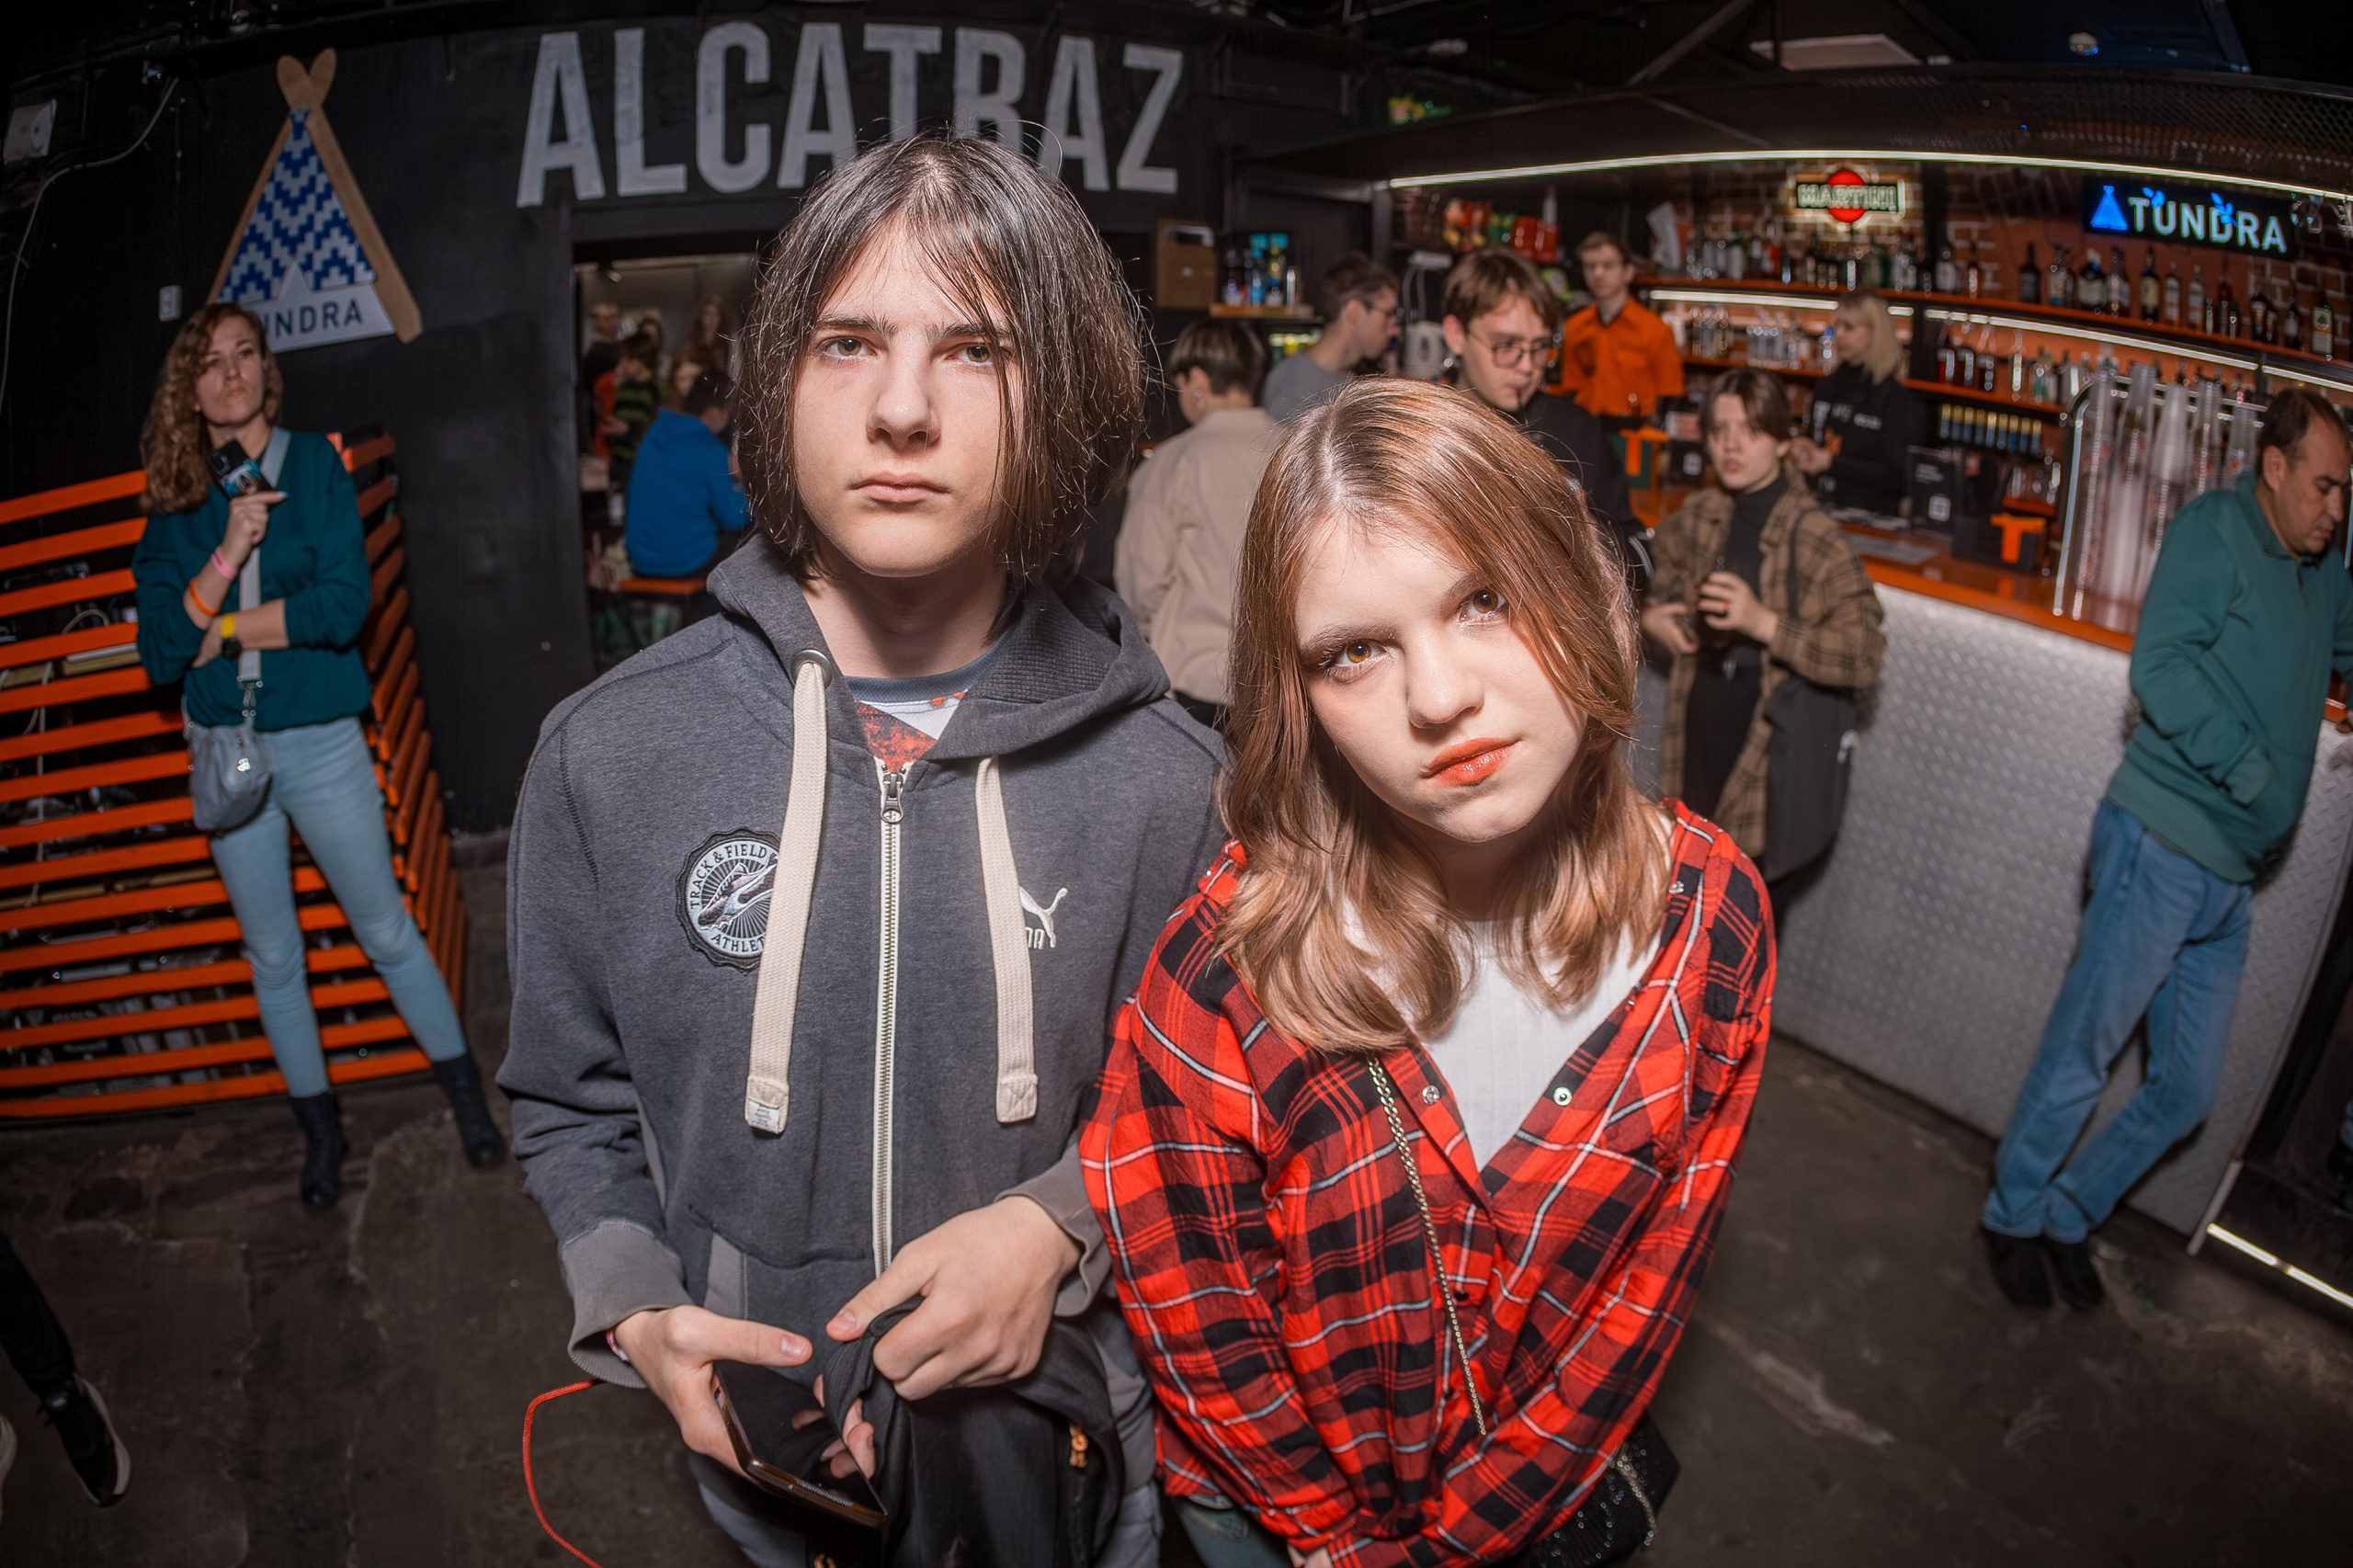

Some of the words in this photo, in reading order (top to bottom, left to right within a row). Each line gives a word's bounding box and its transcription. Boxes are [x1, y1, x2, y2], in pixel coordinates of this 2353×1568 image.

[517, 22, 1183, 208] ALCATRAZ
[2127, 196, 2287, 254] TUNDRA
[262, 299, 363, 339] NDRA
[690, 860, 713, 909] TRACK
[712, 851, 724, 864] &
[724, 844, 767, 858] FIELD
